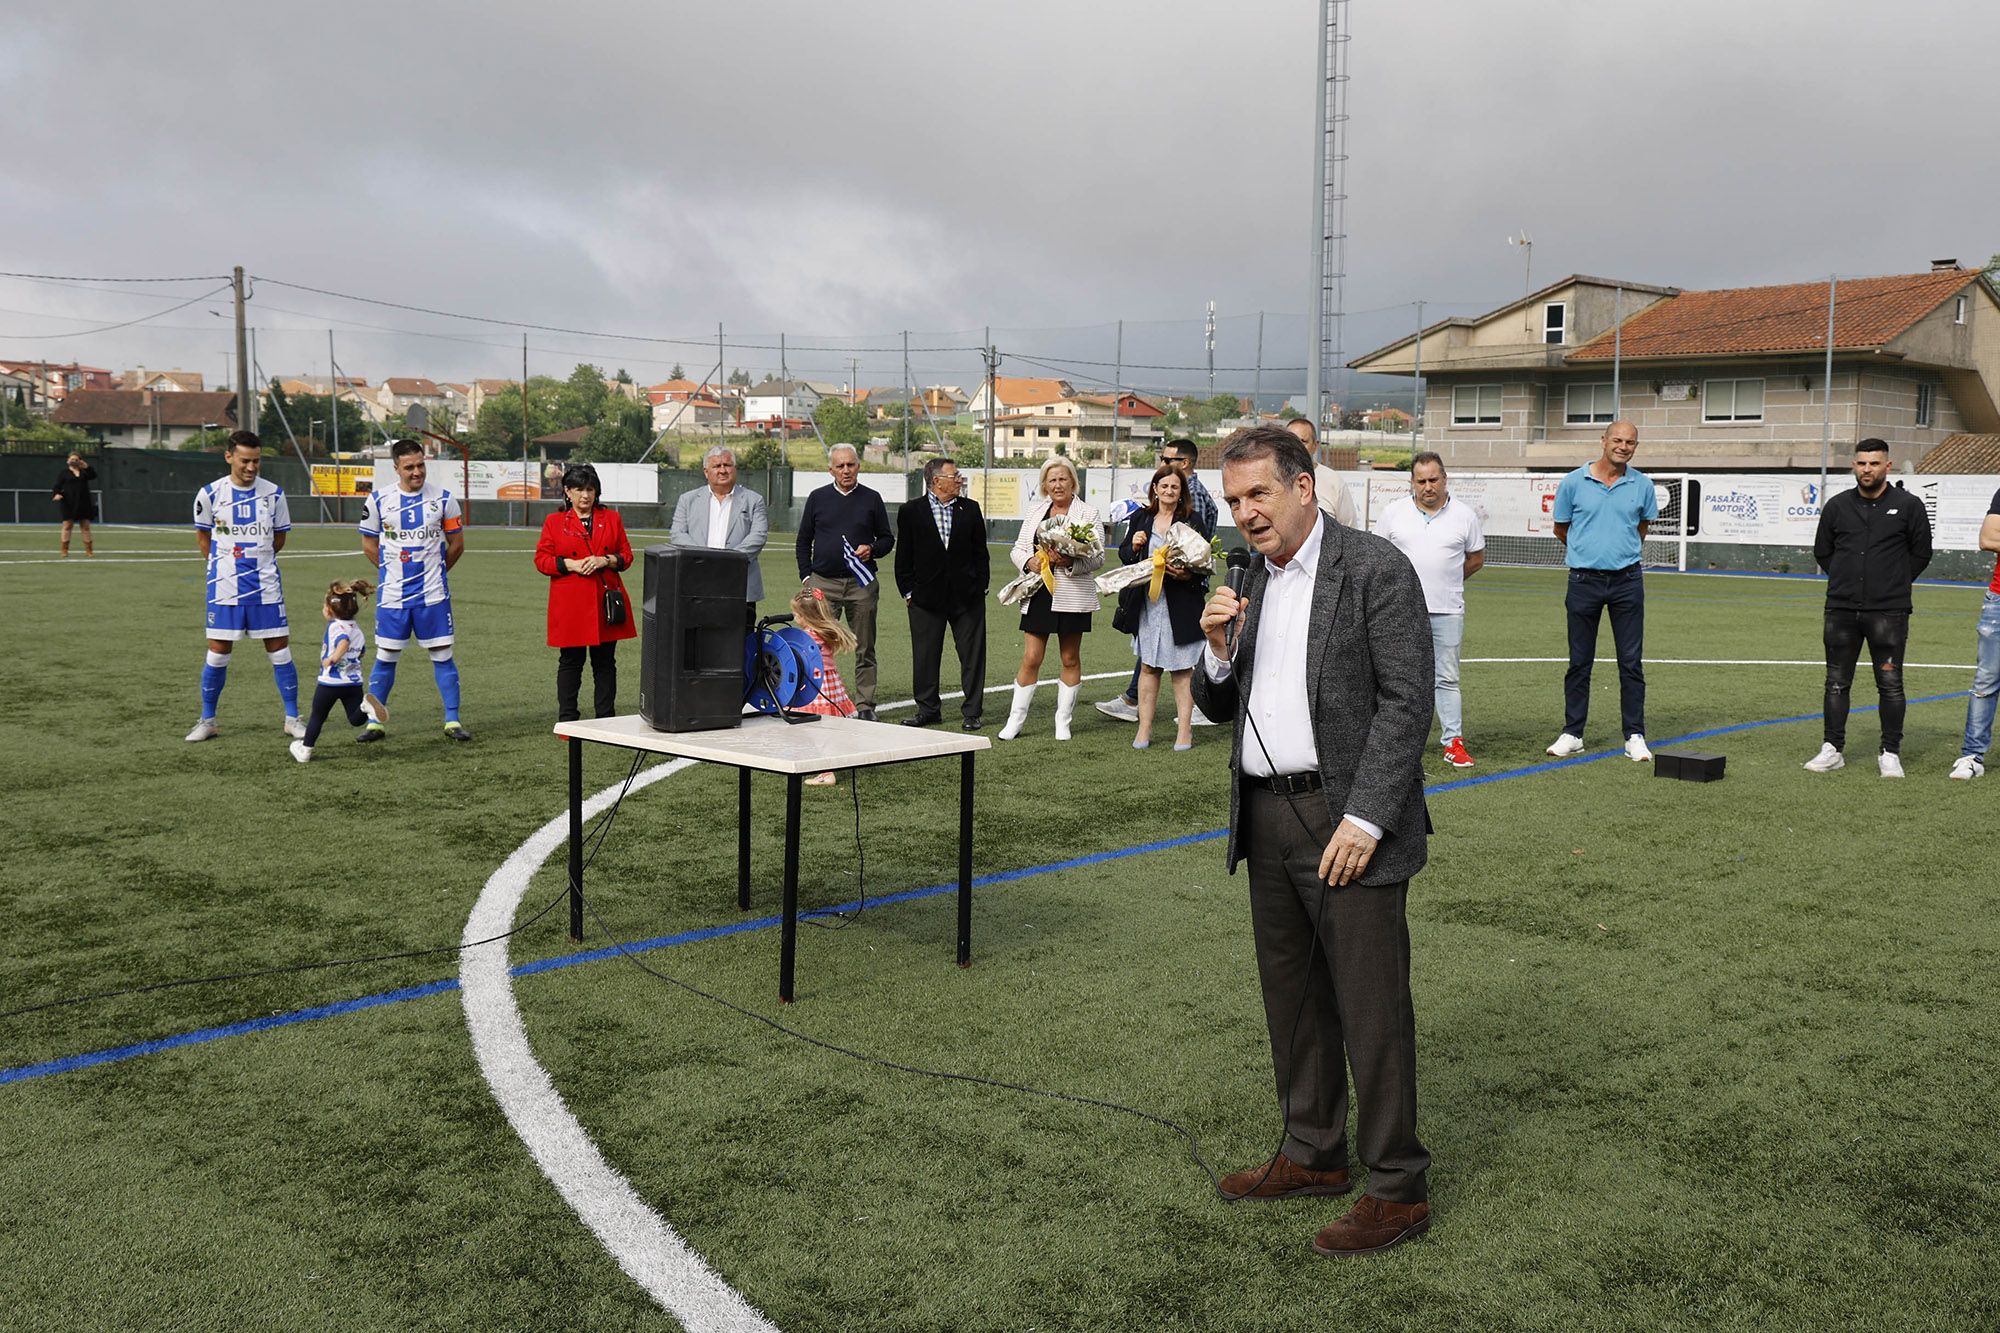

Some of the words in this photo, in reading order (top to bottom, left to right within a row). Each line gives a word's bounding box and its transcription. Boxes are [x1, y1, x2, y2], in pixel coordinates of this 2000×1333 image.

[1704, 495, 1744, 504] PASAXE
[237, 504, 251, 518] 10
[1711, 504, 1746, 513] MOTOR
[408, 509, 416, 524] 3
[446, 612, 453, 627] 3
